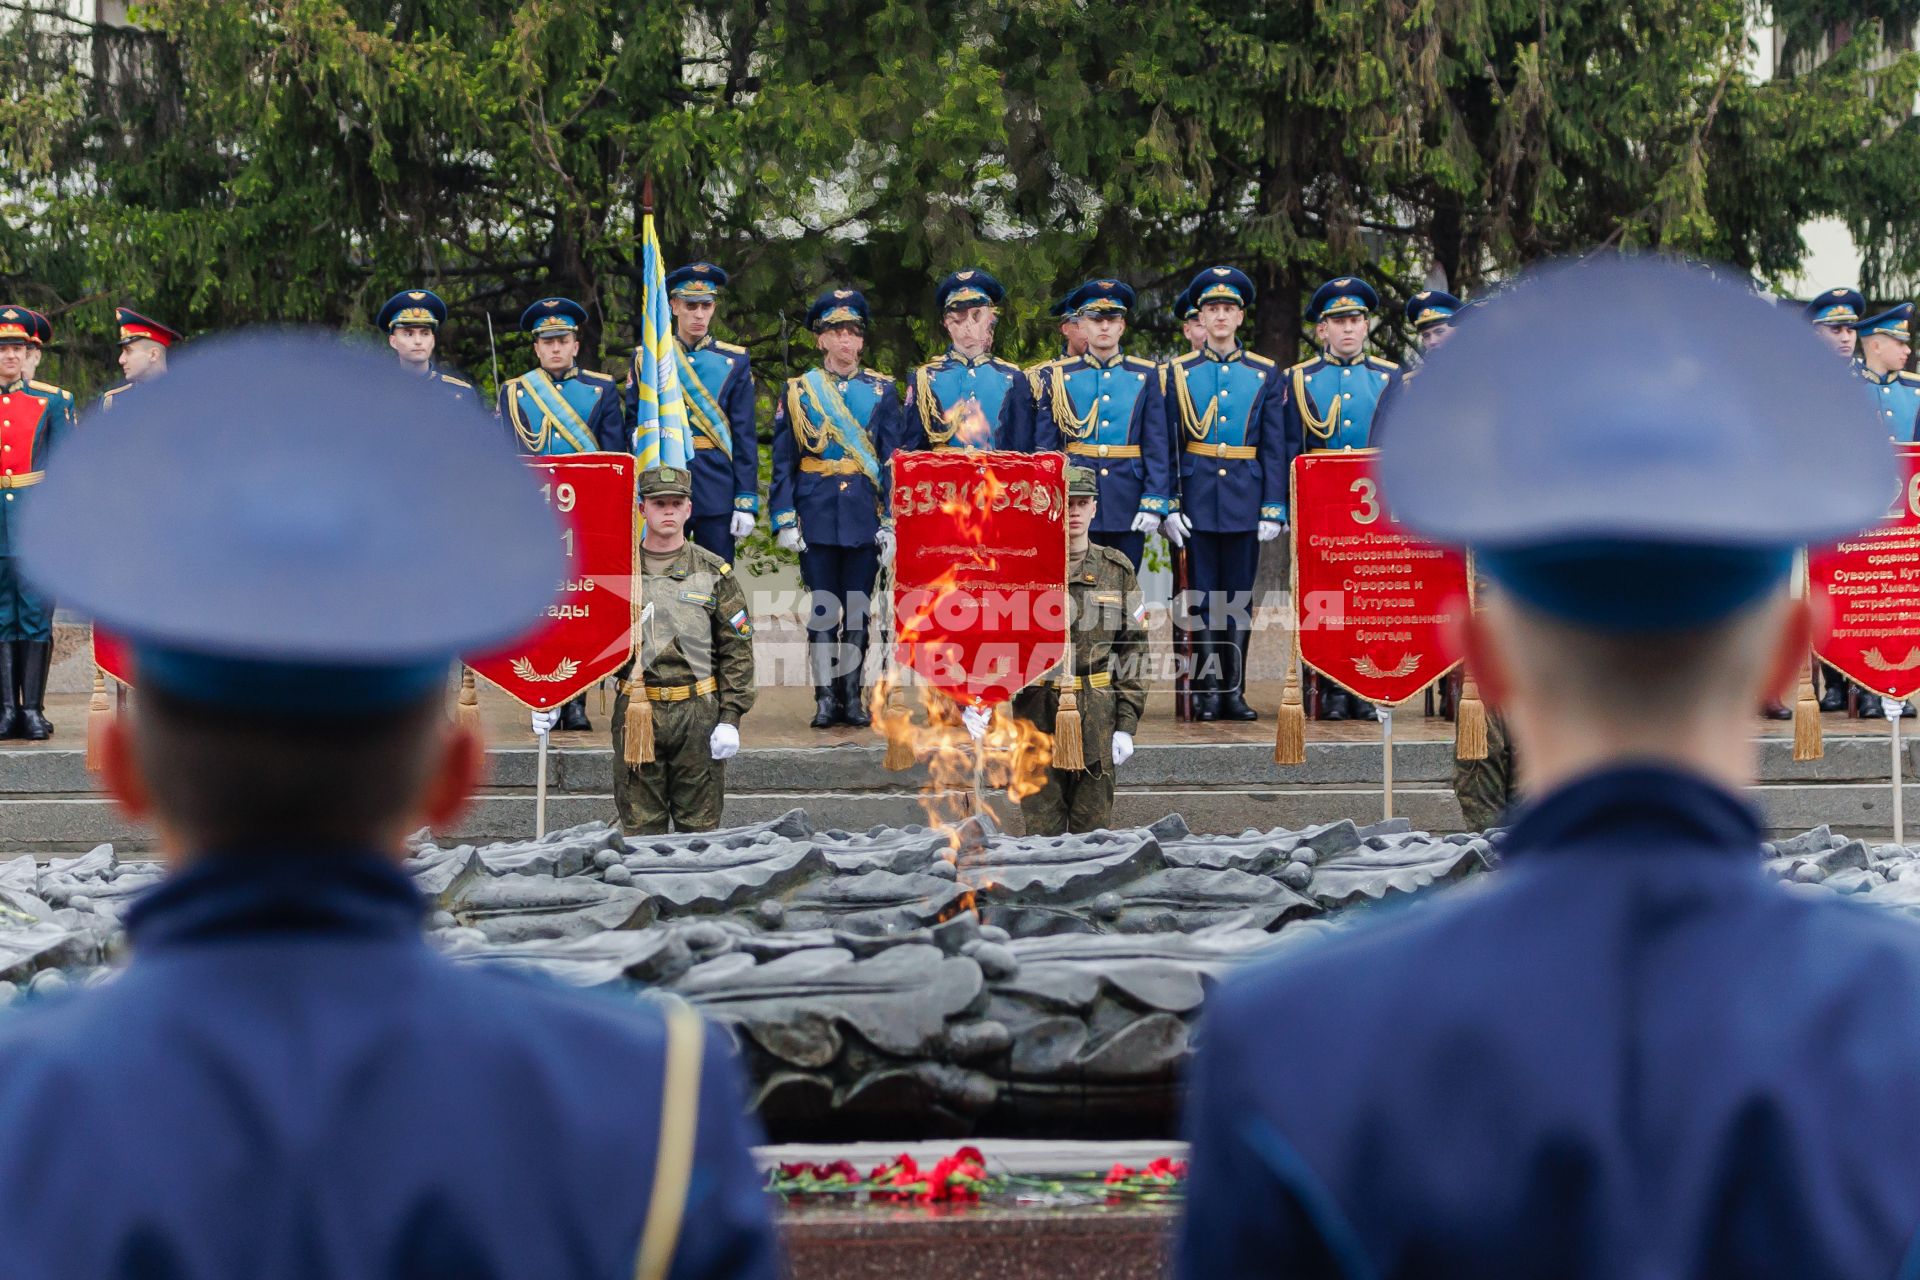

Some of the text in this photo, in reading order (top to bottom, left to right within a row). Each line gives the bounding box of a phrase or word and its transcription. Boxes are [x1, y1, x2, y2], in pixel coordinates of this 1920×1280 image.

[1868, 553, 1919, 566] орденов
[1353, 563, 1412, 577] орденов
[1834, 569, 1897, 583] Суворова,
[1343, 578, 1423, 593] Суворова и
[1828, 583, 1878, 596] Богдана
[1352, 595, 1415, 610] Кутузова
[1356, 629, 1412, 644] бригада
